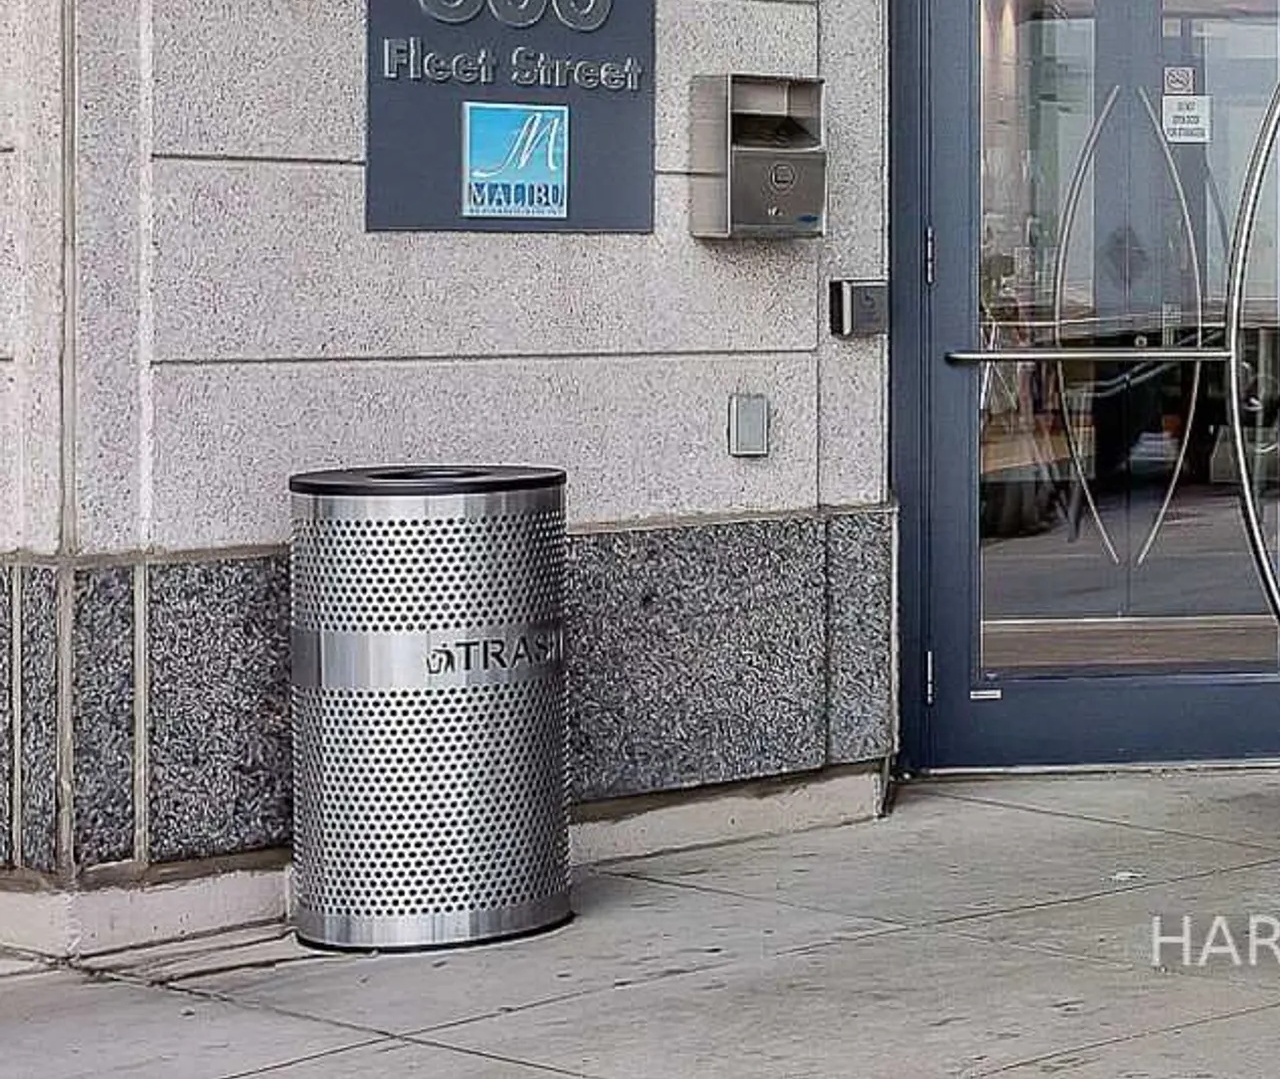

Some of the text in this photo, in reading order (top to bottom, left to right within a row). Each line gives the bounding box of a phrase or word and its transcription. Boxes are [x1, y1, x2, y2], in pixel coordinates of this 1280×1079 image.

[384, 37, 641, 91] Fleet Street
[471, 182, 563, 208] MALIBU
